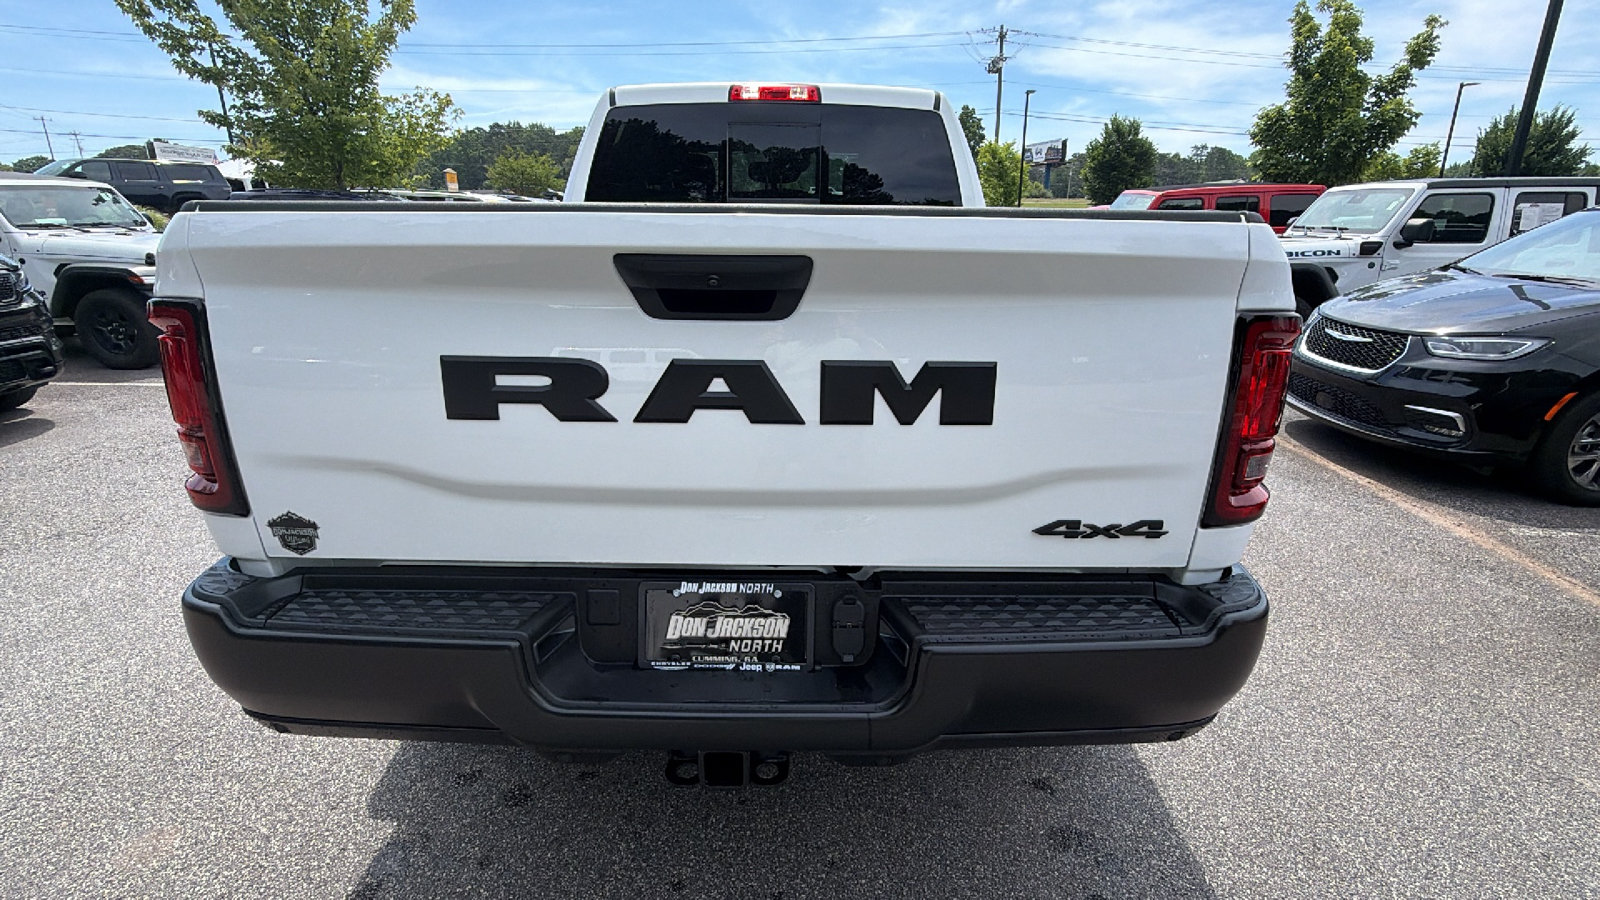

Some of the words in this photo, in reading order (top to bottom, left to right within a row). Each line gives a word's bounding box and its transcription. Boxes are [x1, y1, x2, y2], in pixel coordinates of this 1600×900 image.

[440, 355, 998, 425] RAM
[1031, 519, 1169, 538] 4x4
[680, 582, 698, 594] DON
[698, 582, 738, 594] JACKSON
[739, 583, 774, 594] NORTH
[666, 615, 707, 639] DON
[706, 616, 790, 639] JACKSON
[729, 640, 783, 653] NORTH
[739, 662, 763, 673] Jeep
